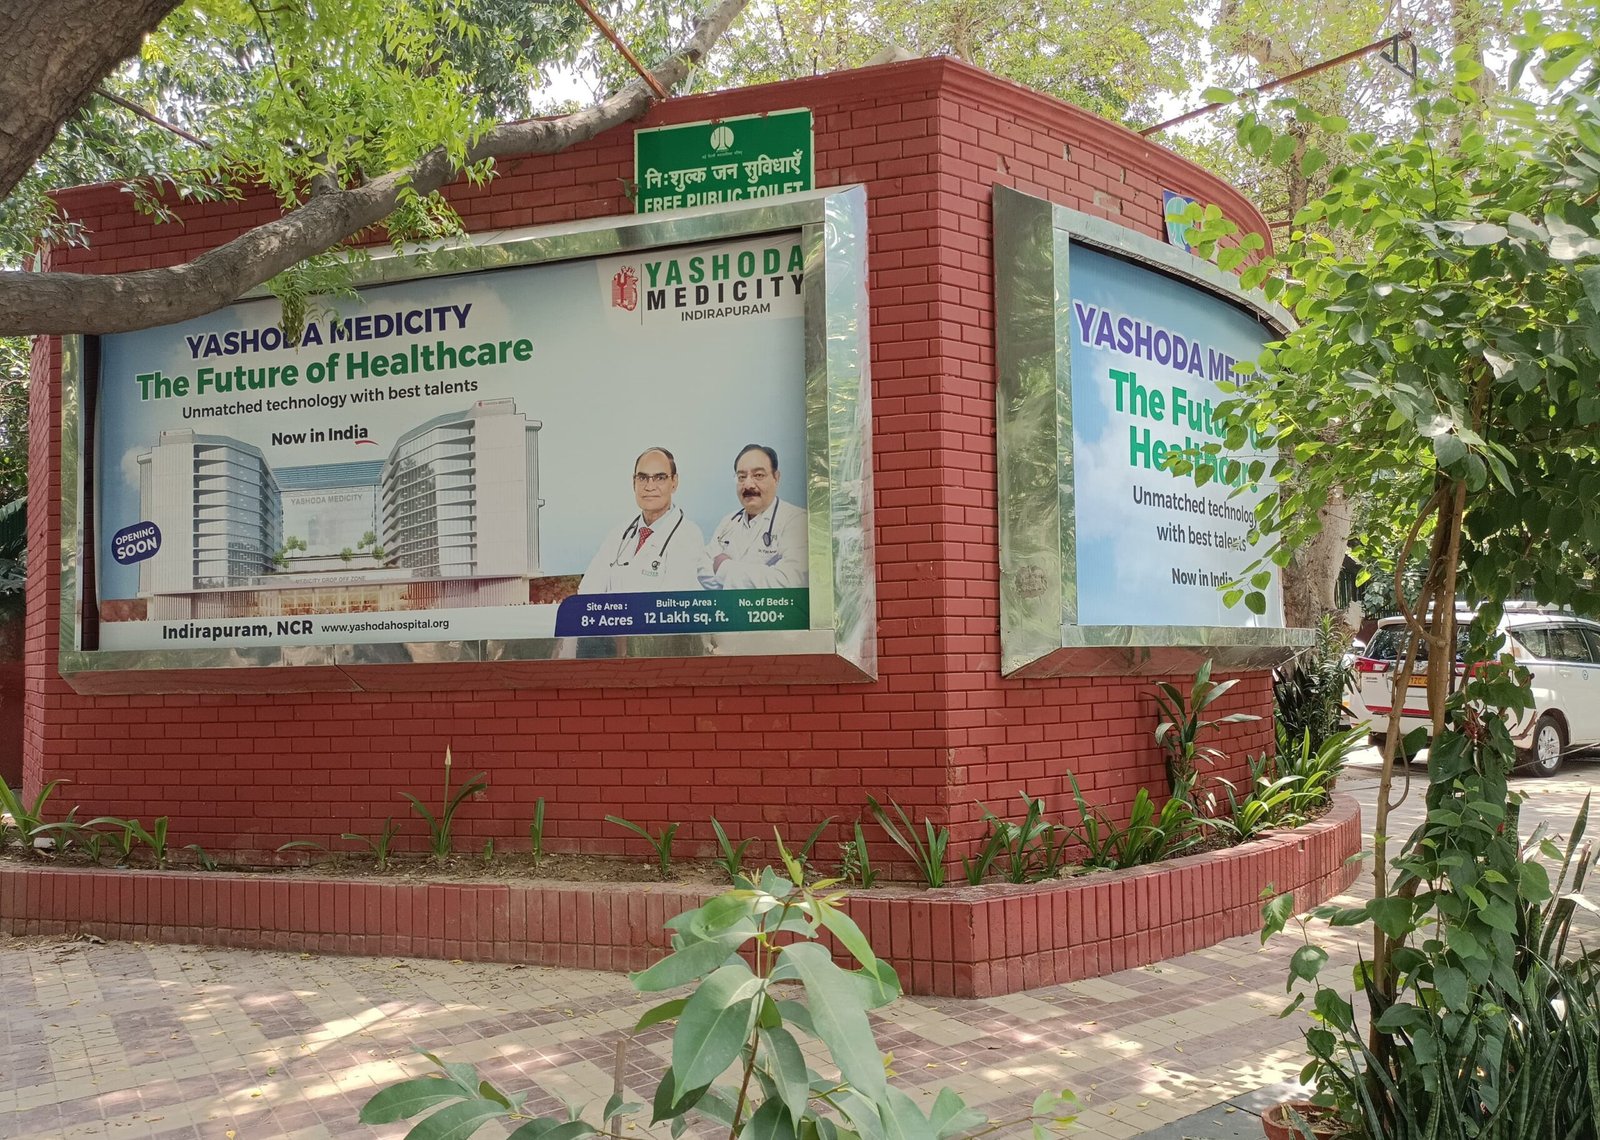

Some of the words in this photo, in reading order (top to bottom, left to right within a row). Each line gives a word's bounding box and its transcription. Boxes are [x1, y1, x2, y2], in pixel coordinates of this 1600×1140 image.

[711, 163, 738, 180] जन
[645, 245, 804, 288] YASHODA
[647, 274, 804, 311] MEDICITY
[330, 303, 473, 344] MEDICITY
[681, 303, 771, 322] INDIRAPURAM
[1075, 302, 1204, 379] YASHODA
[136, 371, 190, 400] The
[197, 365, 299, 395] Future
[306, 352, 340, 384] of
[346, 338, 534, 380] Healthcare
[182, 400, 263, 419] Unmatched
[266, 391, 347, 414] technology
[350, 388, 385, 403] with
[388, 385, 421, 400] best
[424, 379, 479, 396] talents
[1109, 368, 1165, 421] The
[271, 432, 307, 446] Now
[310, 428, 325, 442] in
[328, 424, 369, 441] India
[1133, 485, 1206, 514] Unmatched
[115, 526, 155, 546] OPENING
[1156, 522, 1186, 543] with
[1188, 525, 1212, 547] best
[117, 536, 158, 560] SOON
[1171, 568, 1197, 585] Now
[1198, 569, 1209, 587] in
[586, 603, 603, 612] Site
[604, 602, 623, 611] Area
[656, 598, 690, 609] Built-up
[692, 597, 713, 607] Area
[738, 598, 754, 607] No.
[756, 597, 765, 606] of
[767, 597, 788, 606] Beds
[581, 615, 596, 627] 8+
[598, 613, 634, 627] Acres
[644, 612, 656, 624] 12
[659, 610, 691, 624] Lakh
[693, 613, 712, 625] sq.
[714, 609, 729, 623] ft.
[747, 610, 785, 624] 1200+
[162, 622, 272, 642] Indirapuram,
[277, 620, 313, 636] NCR
[321, 619, 450, 635] www.yashodahospital.org
